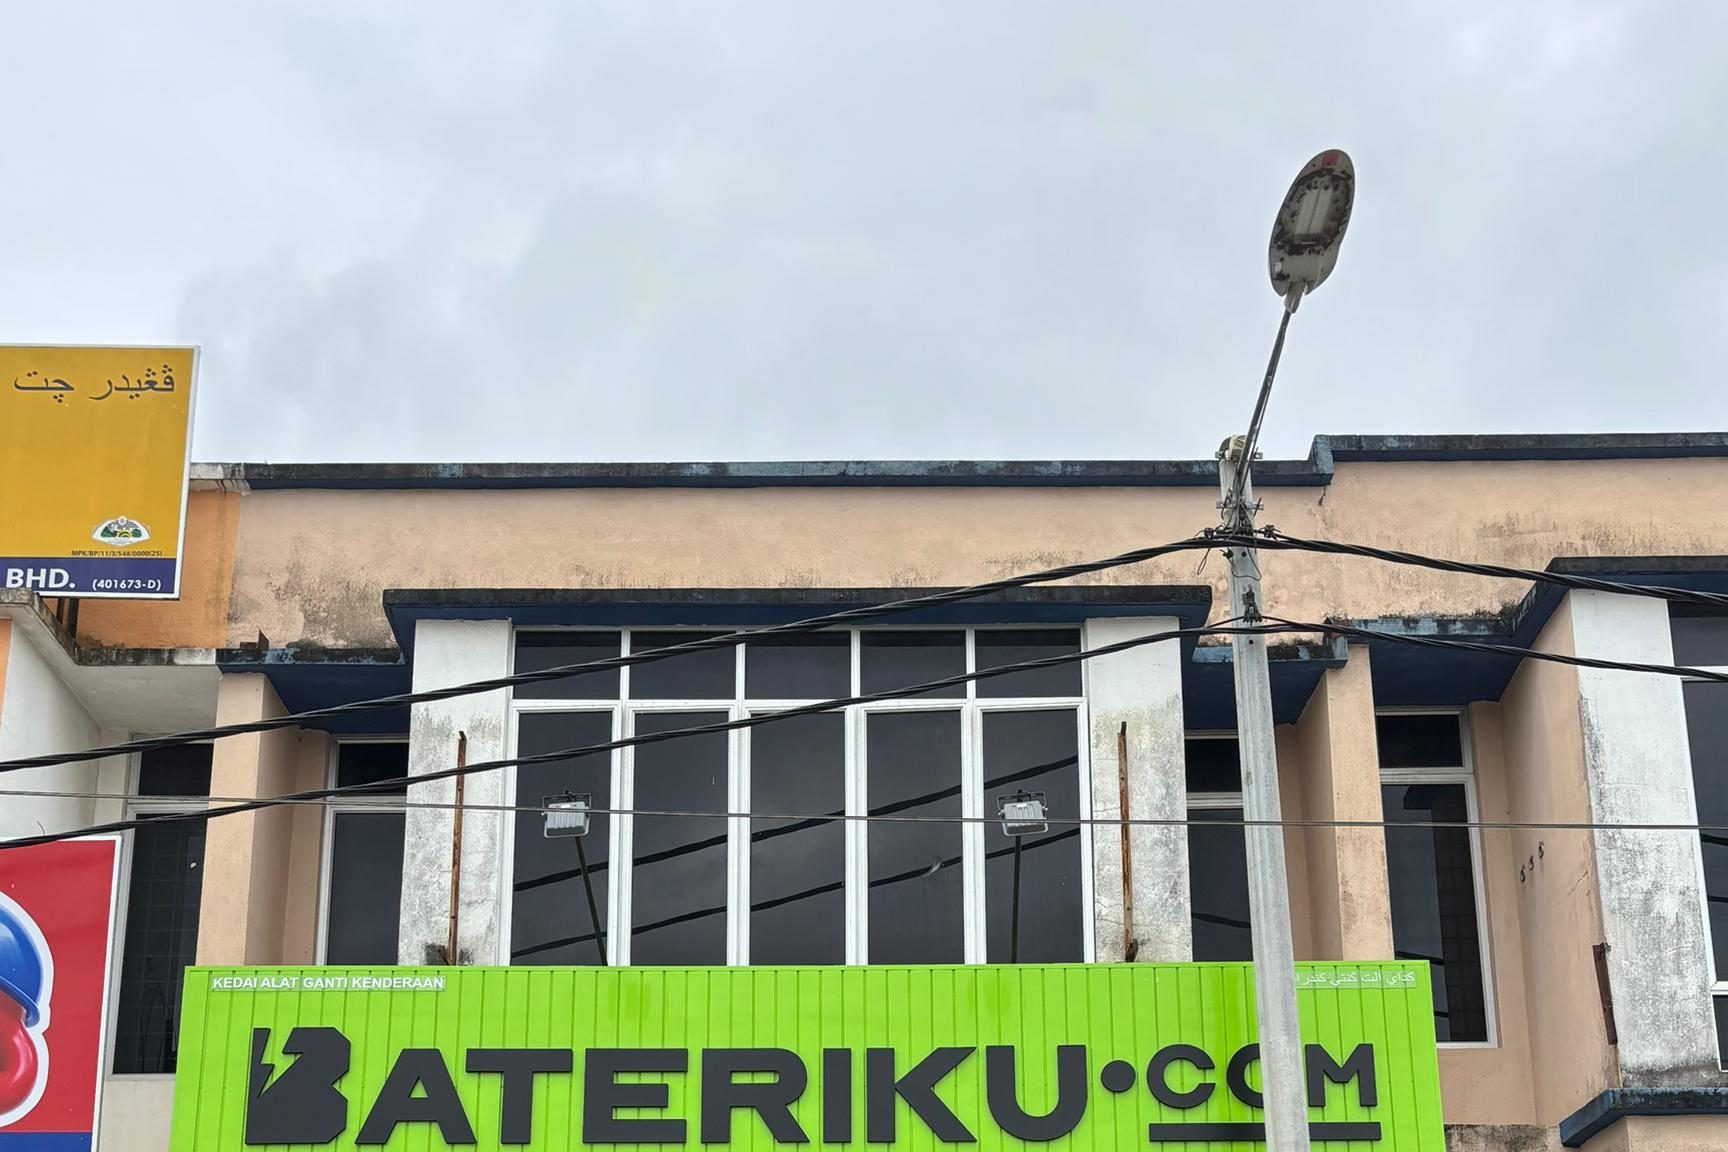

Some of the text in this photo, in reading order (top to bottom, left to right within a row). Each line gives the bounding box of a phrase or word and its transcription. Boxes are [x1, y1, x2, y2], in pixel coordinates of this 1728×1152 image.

[6, 568, 162, 591] BHD. (401673-D)
[213, 975, 445, 990] KEDAI ALAT GANTI KENDERAAN
